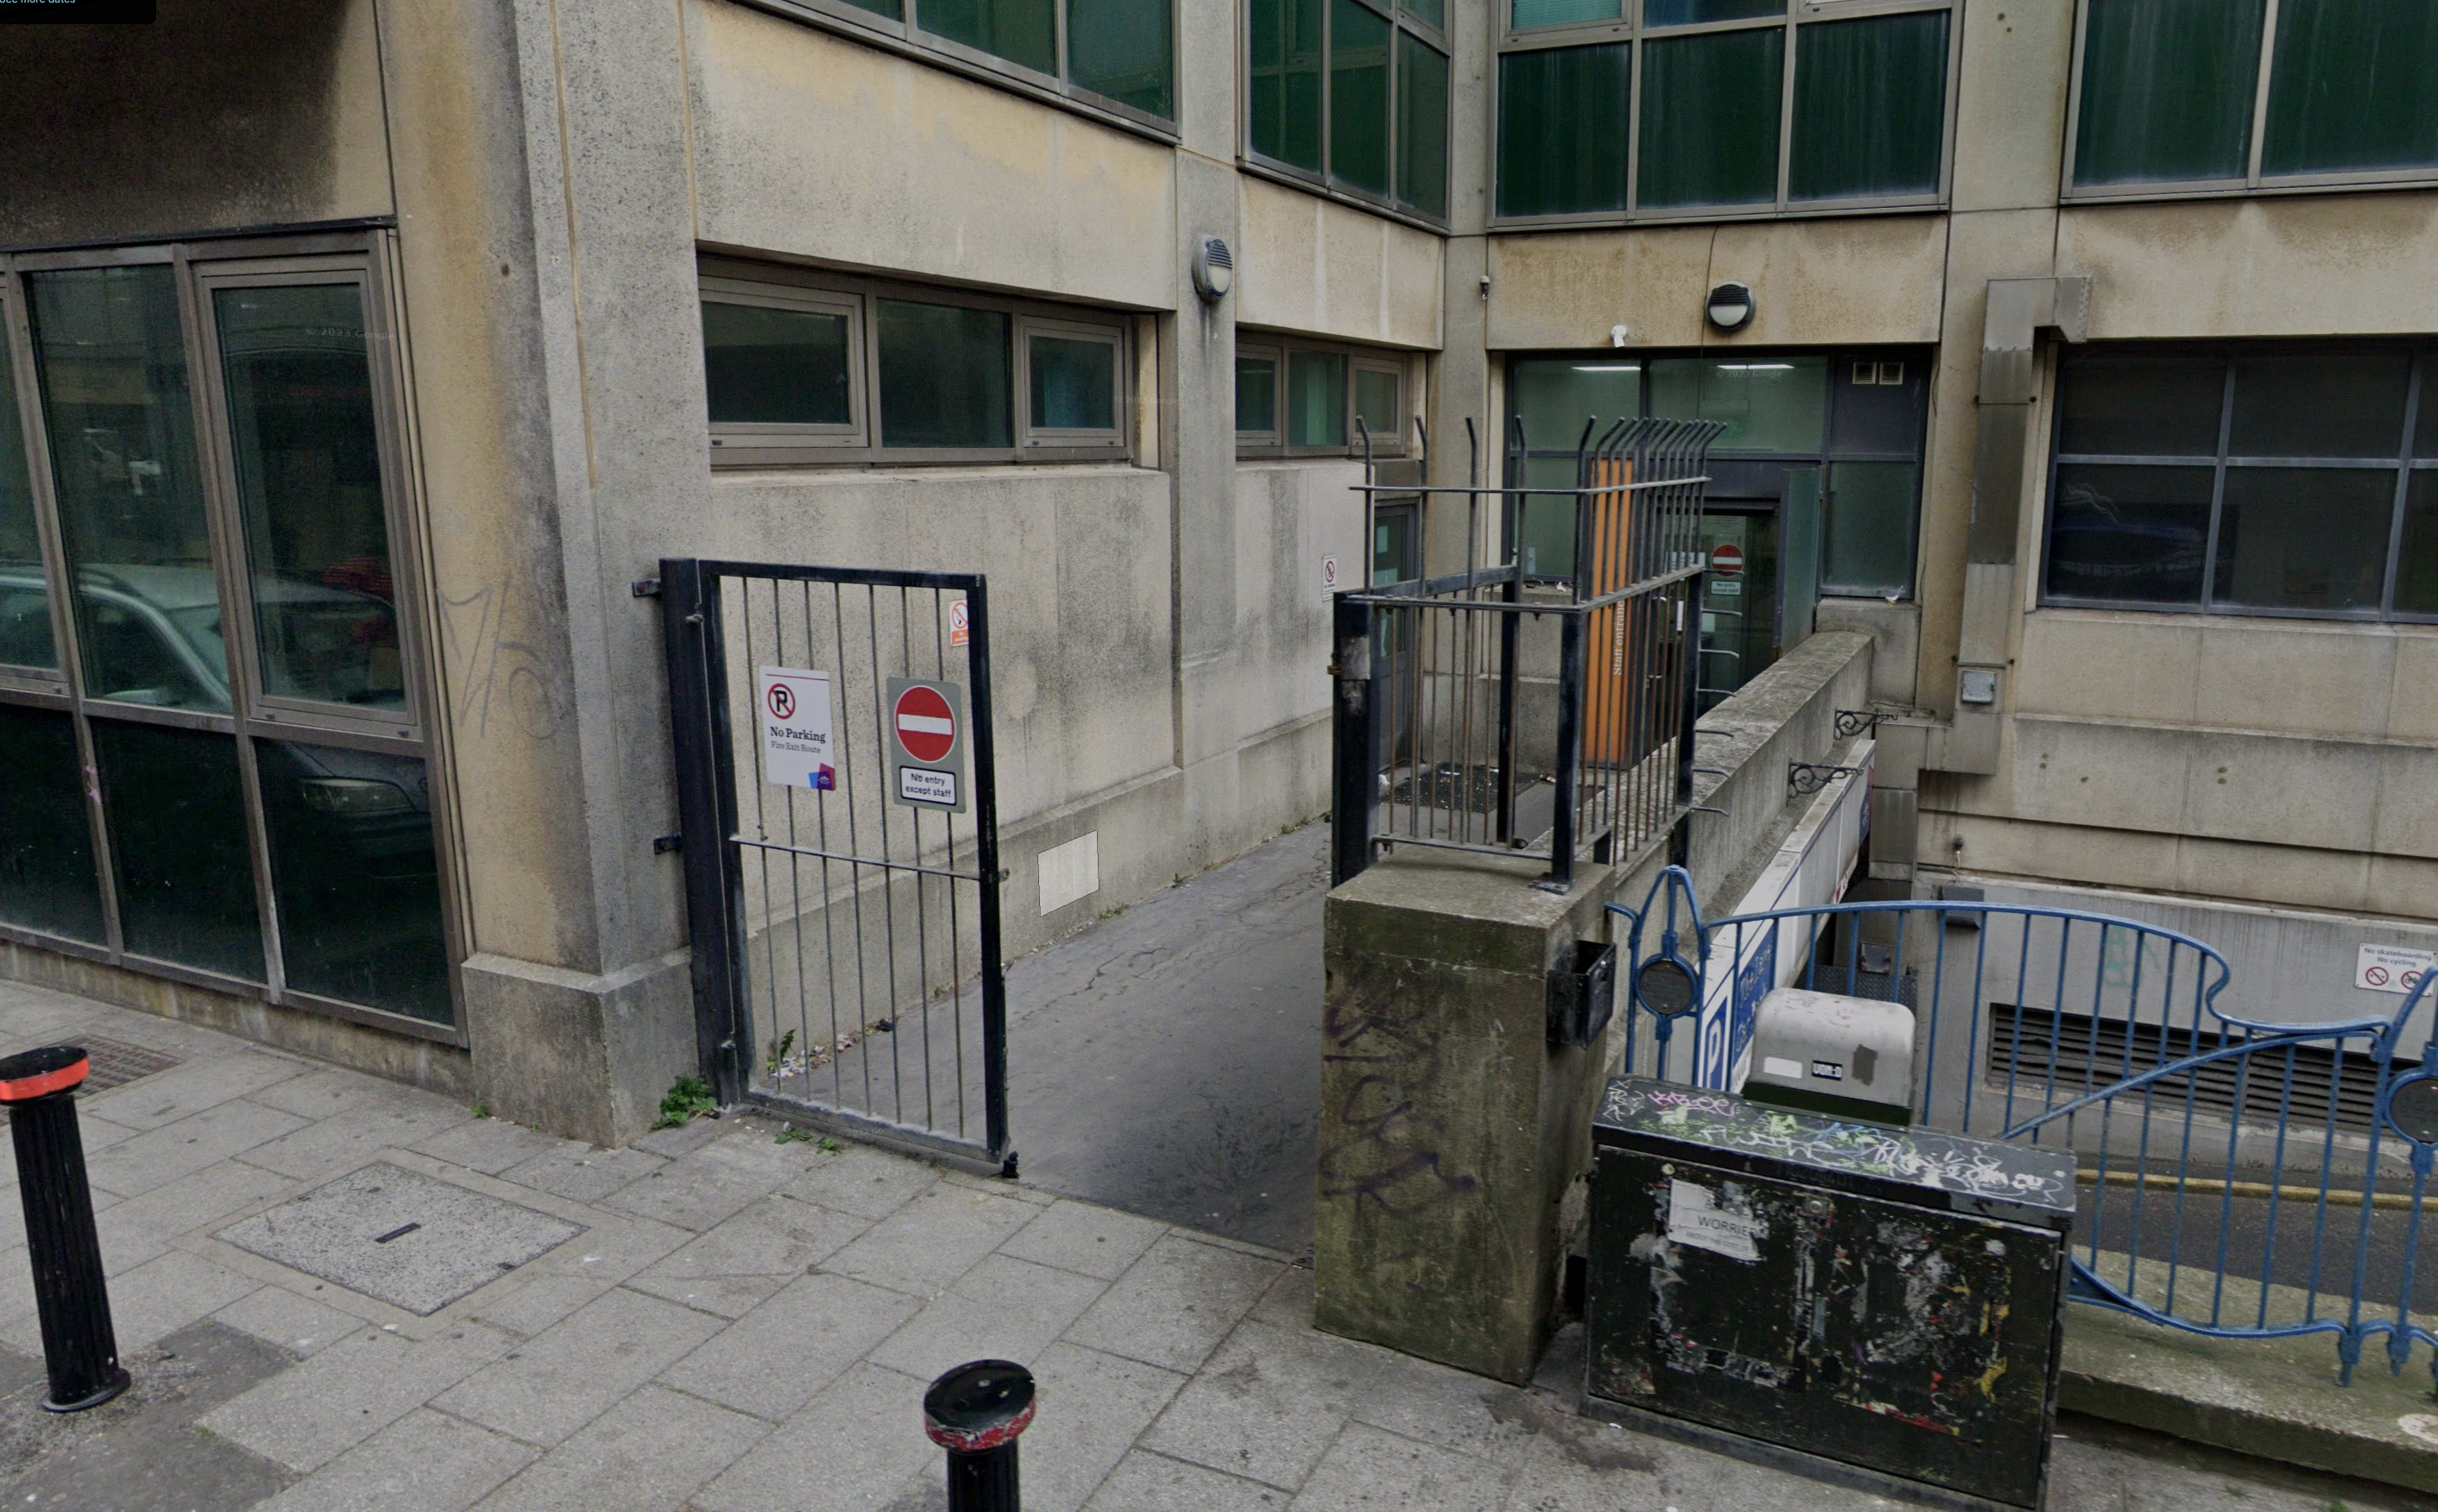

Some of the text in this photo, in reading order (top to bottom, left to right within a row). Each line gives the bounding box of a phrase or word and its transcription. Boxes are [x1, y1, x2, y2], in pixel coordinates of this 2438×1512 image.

[1613, 599, 1626, 676] Staff entranc
[770, 726, 826, 744] No Parking
[771, 740, 821, 753] Fire Exit Route
[910, 772, 945, 786] No entry
[905, 786, 951, 797] except staff
[2378, 948, 2432, 962] skateboarding
[2390, 958, 2416, 967] cycling
